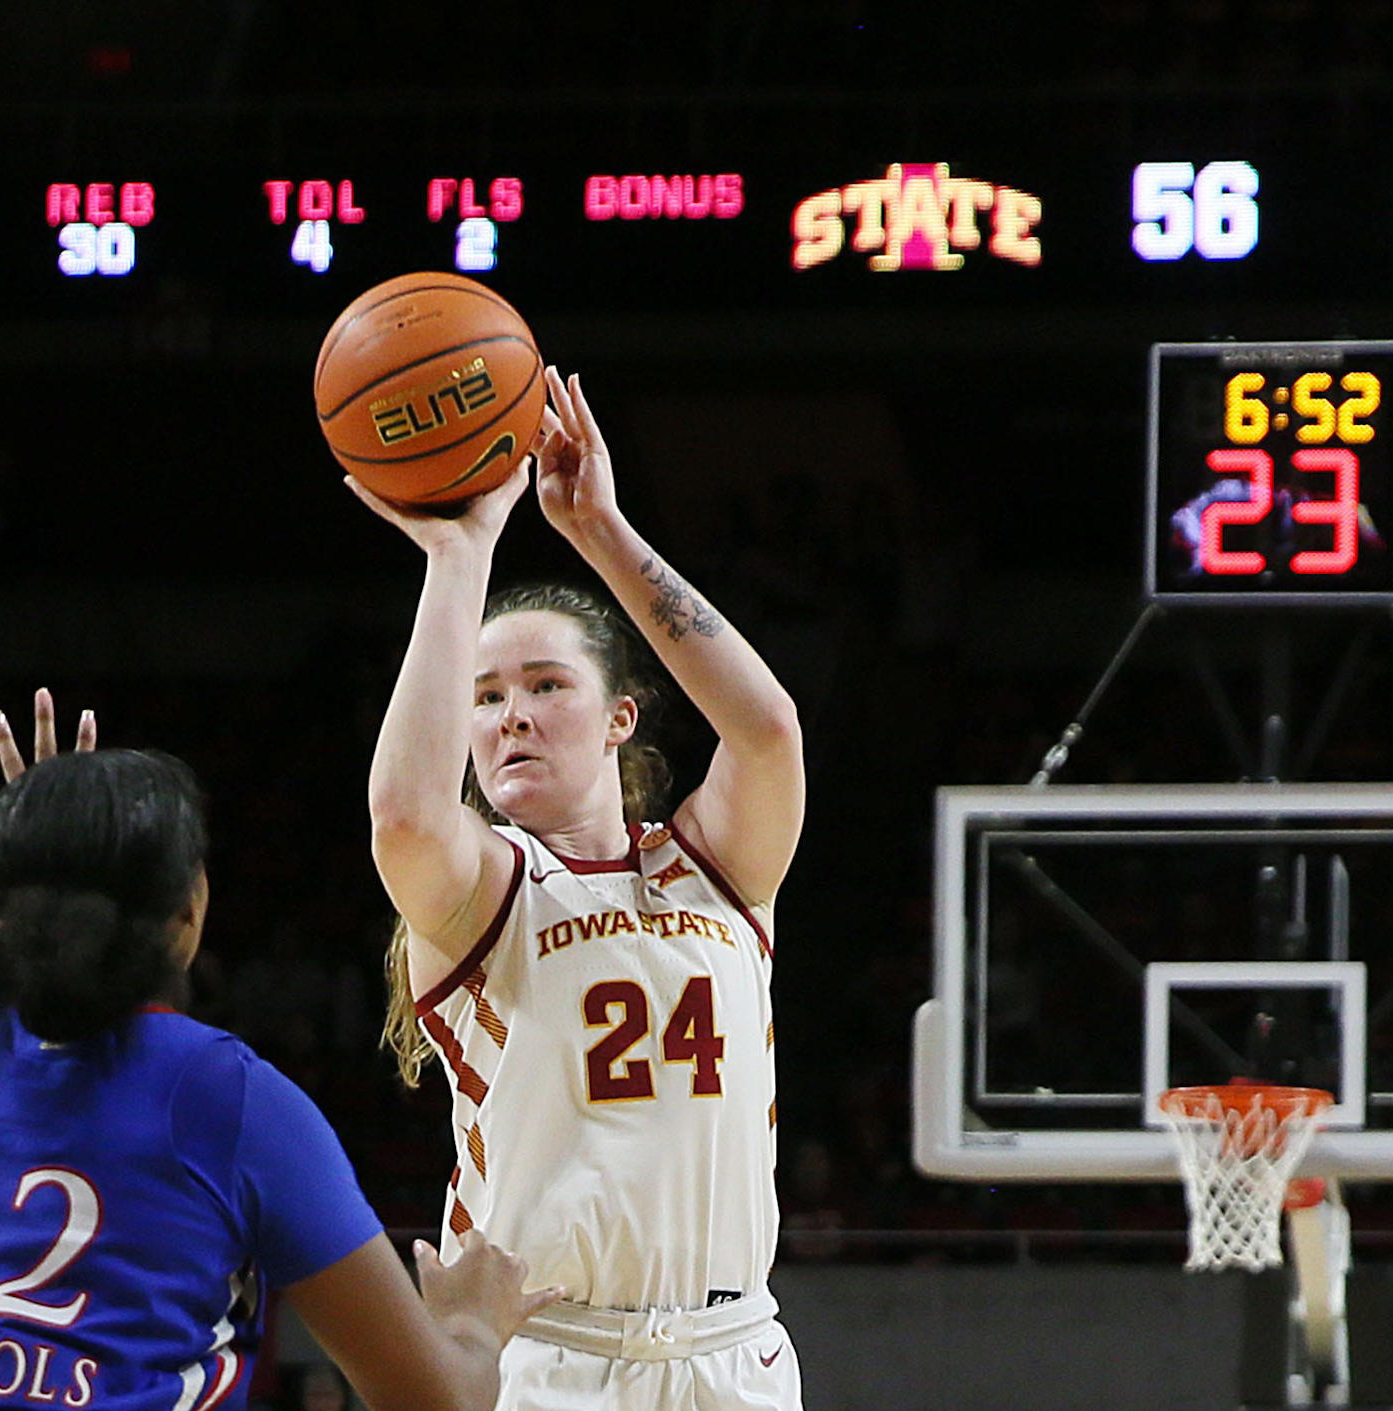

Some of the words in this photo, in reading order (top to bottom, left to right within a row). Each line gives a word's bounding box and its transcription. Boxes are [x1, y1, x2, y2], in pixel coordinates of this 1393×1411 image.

[46, 182, 155, 227] REB
[263, 180, 366, 223] TOL
[427, 178, 524, 221] FLS
[584, 173, 745, 220] BONUS
[790, 174, 1043, 272] STATE
[1130, 160, 1260, 262] 56
[291, 220, 334, 274] 4
[454, 217, 495, 272] 2
[372, 371, 498, 447] ELITE
[1224, 372, 1382, 444] 6:52
[1200, 449, 1360, 575] 23
[536, 910, 637, 960] IOWA
[581, 976, 726, 1104] 24
